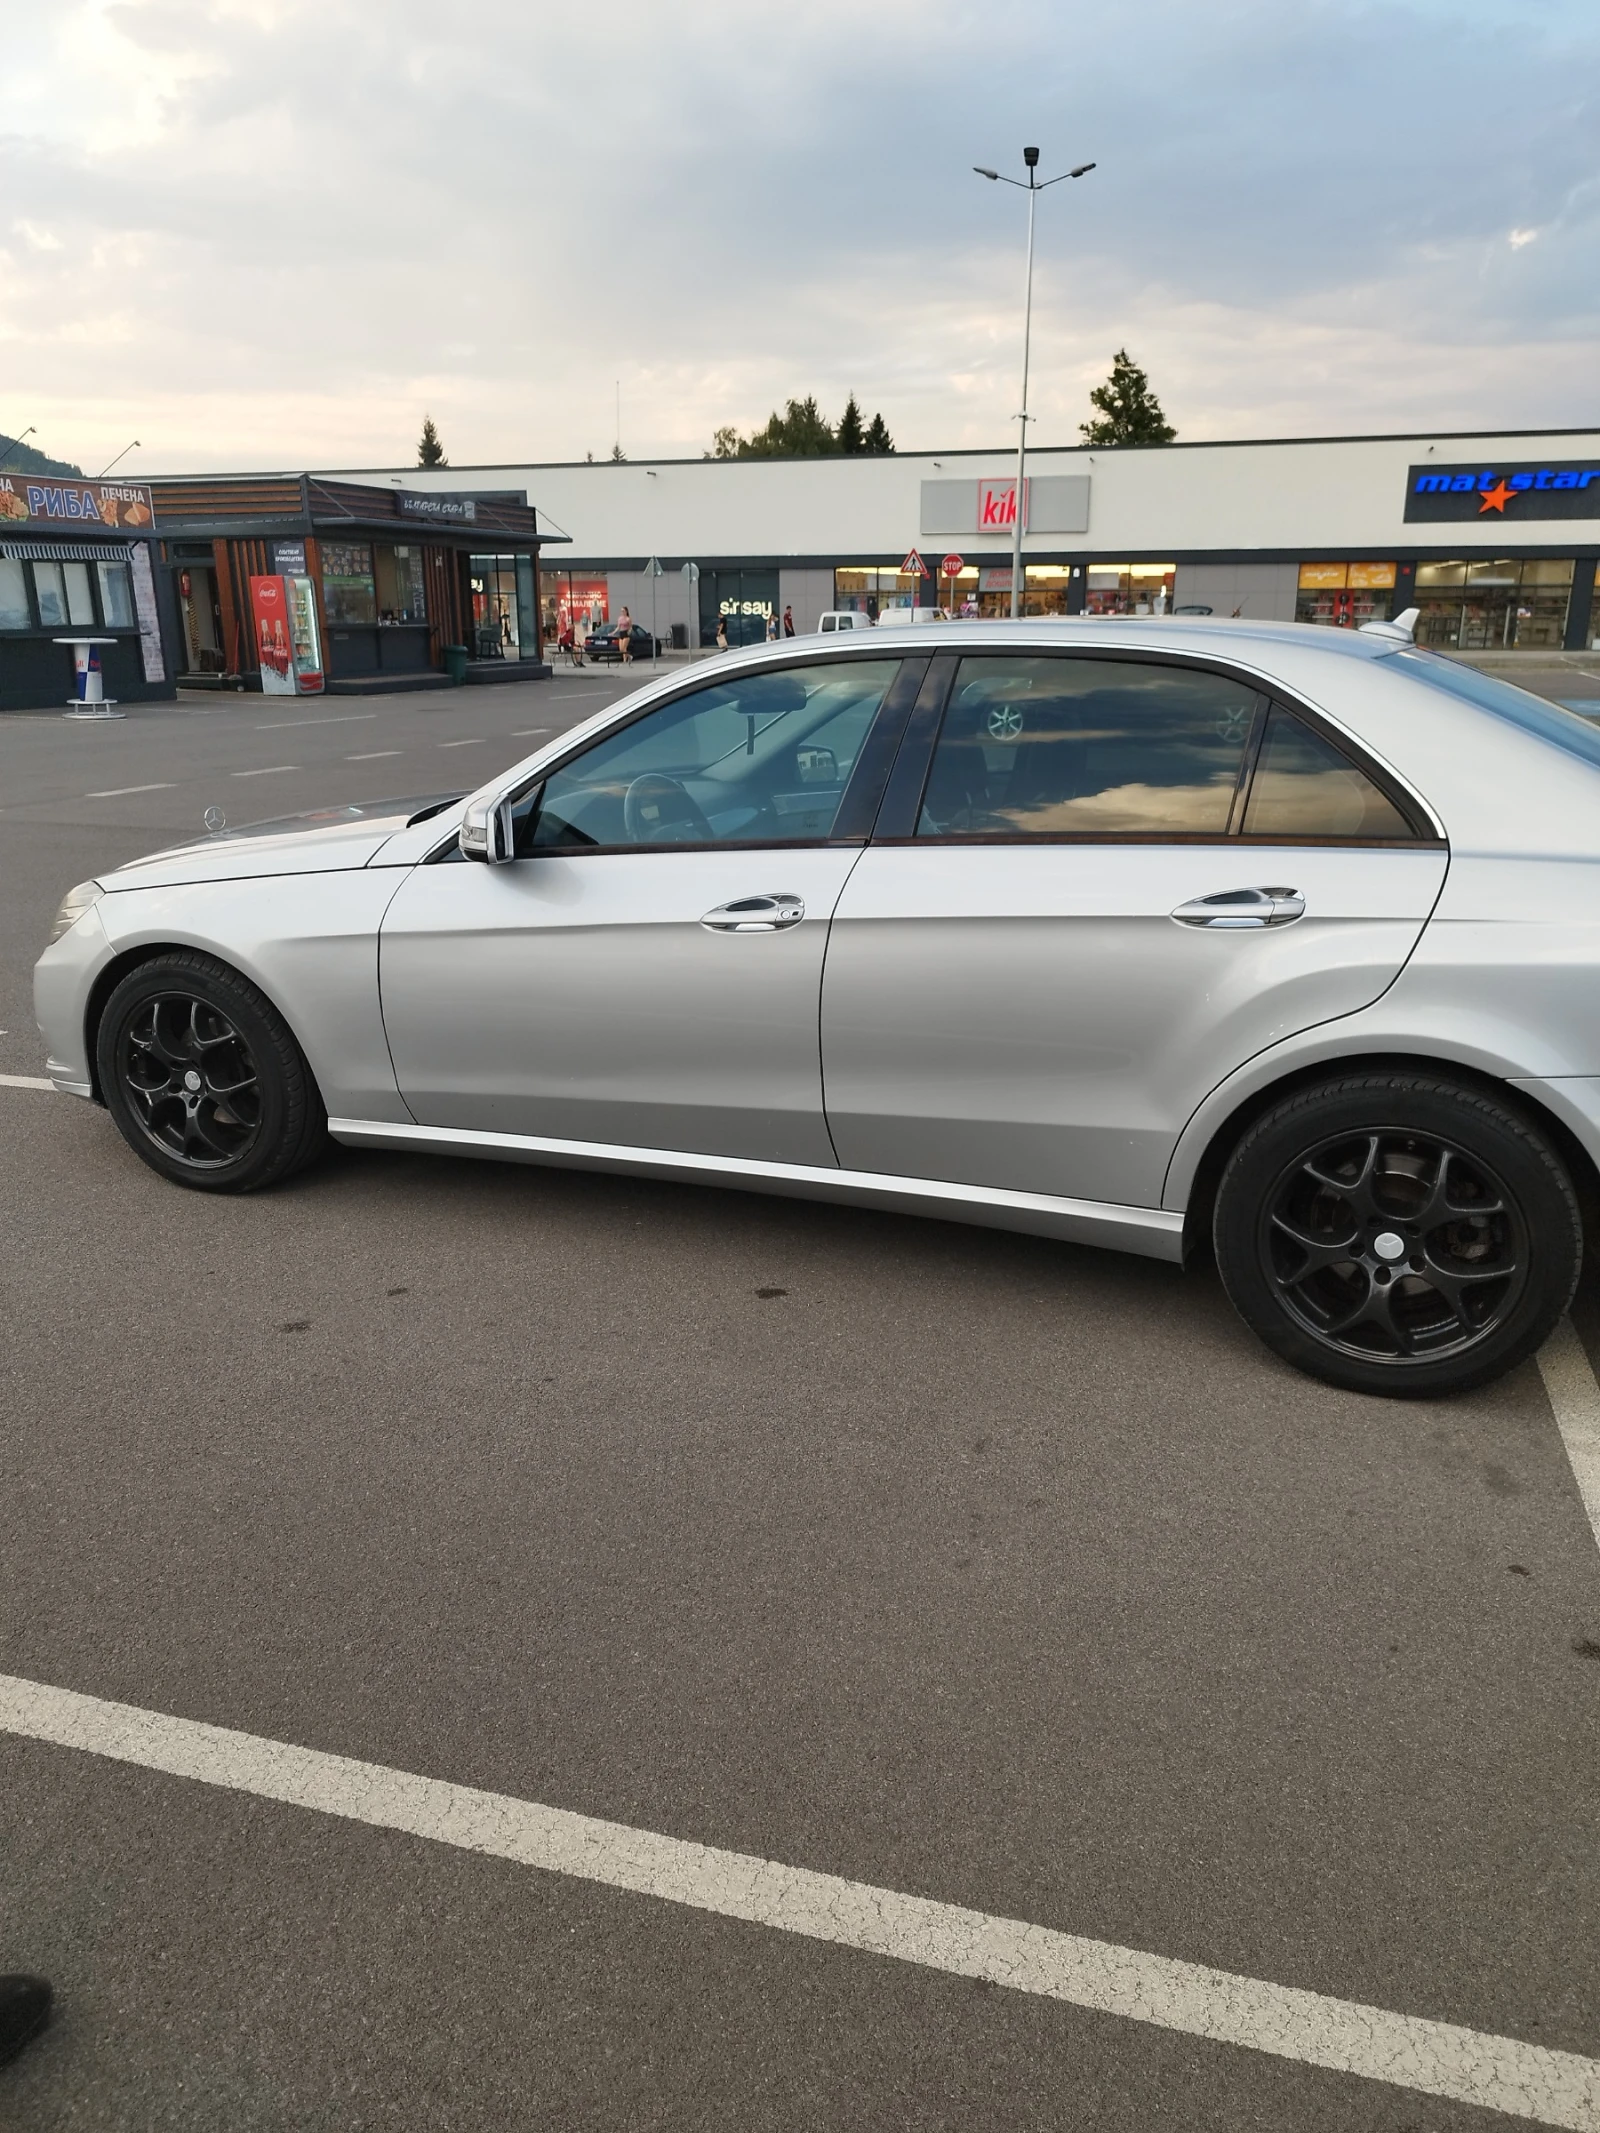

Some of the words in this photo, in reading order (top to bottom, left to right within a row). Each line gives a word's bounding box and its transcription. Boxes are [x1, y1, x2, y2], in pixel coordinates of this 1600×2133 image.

[1415, 470, 1496, 492] mat
[1508, 469, 1600, 490] star
[27, 486, 101, 520] РИБА
[101, 487, 145, 503] ПЕЧЕНА
[944, 561, 962, 571] STOP
